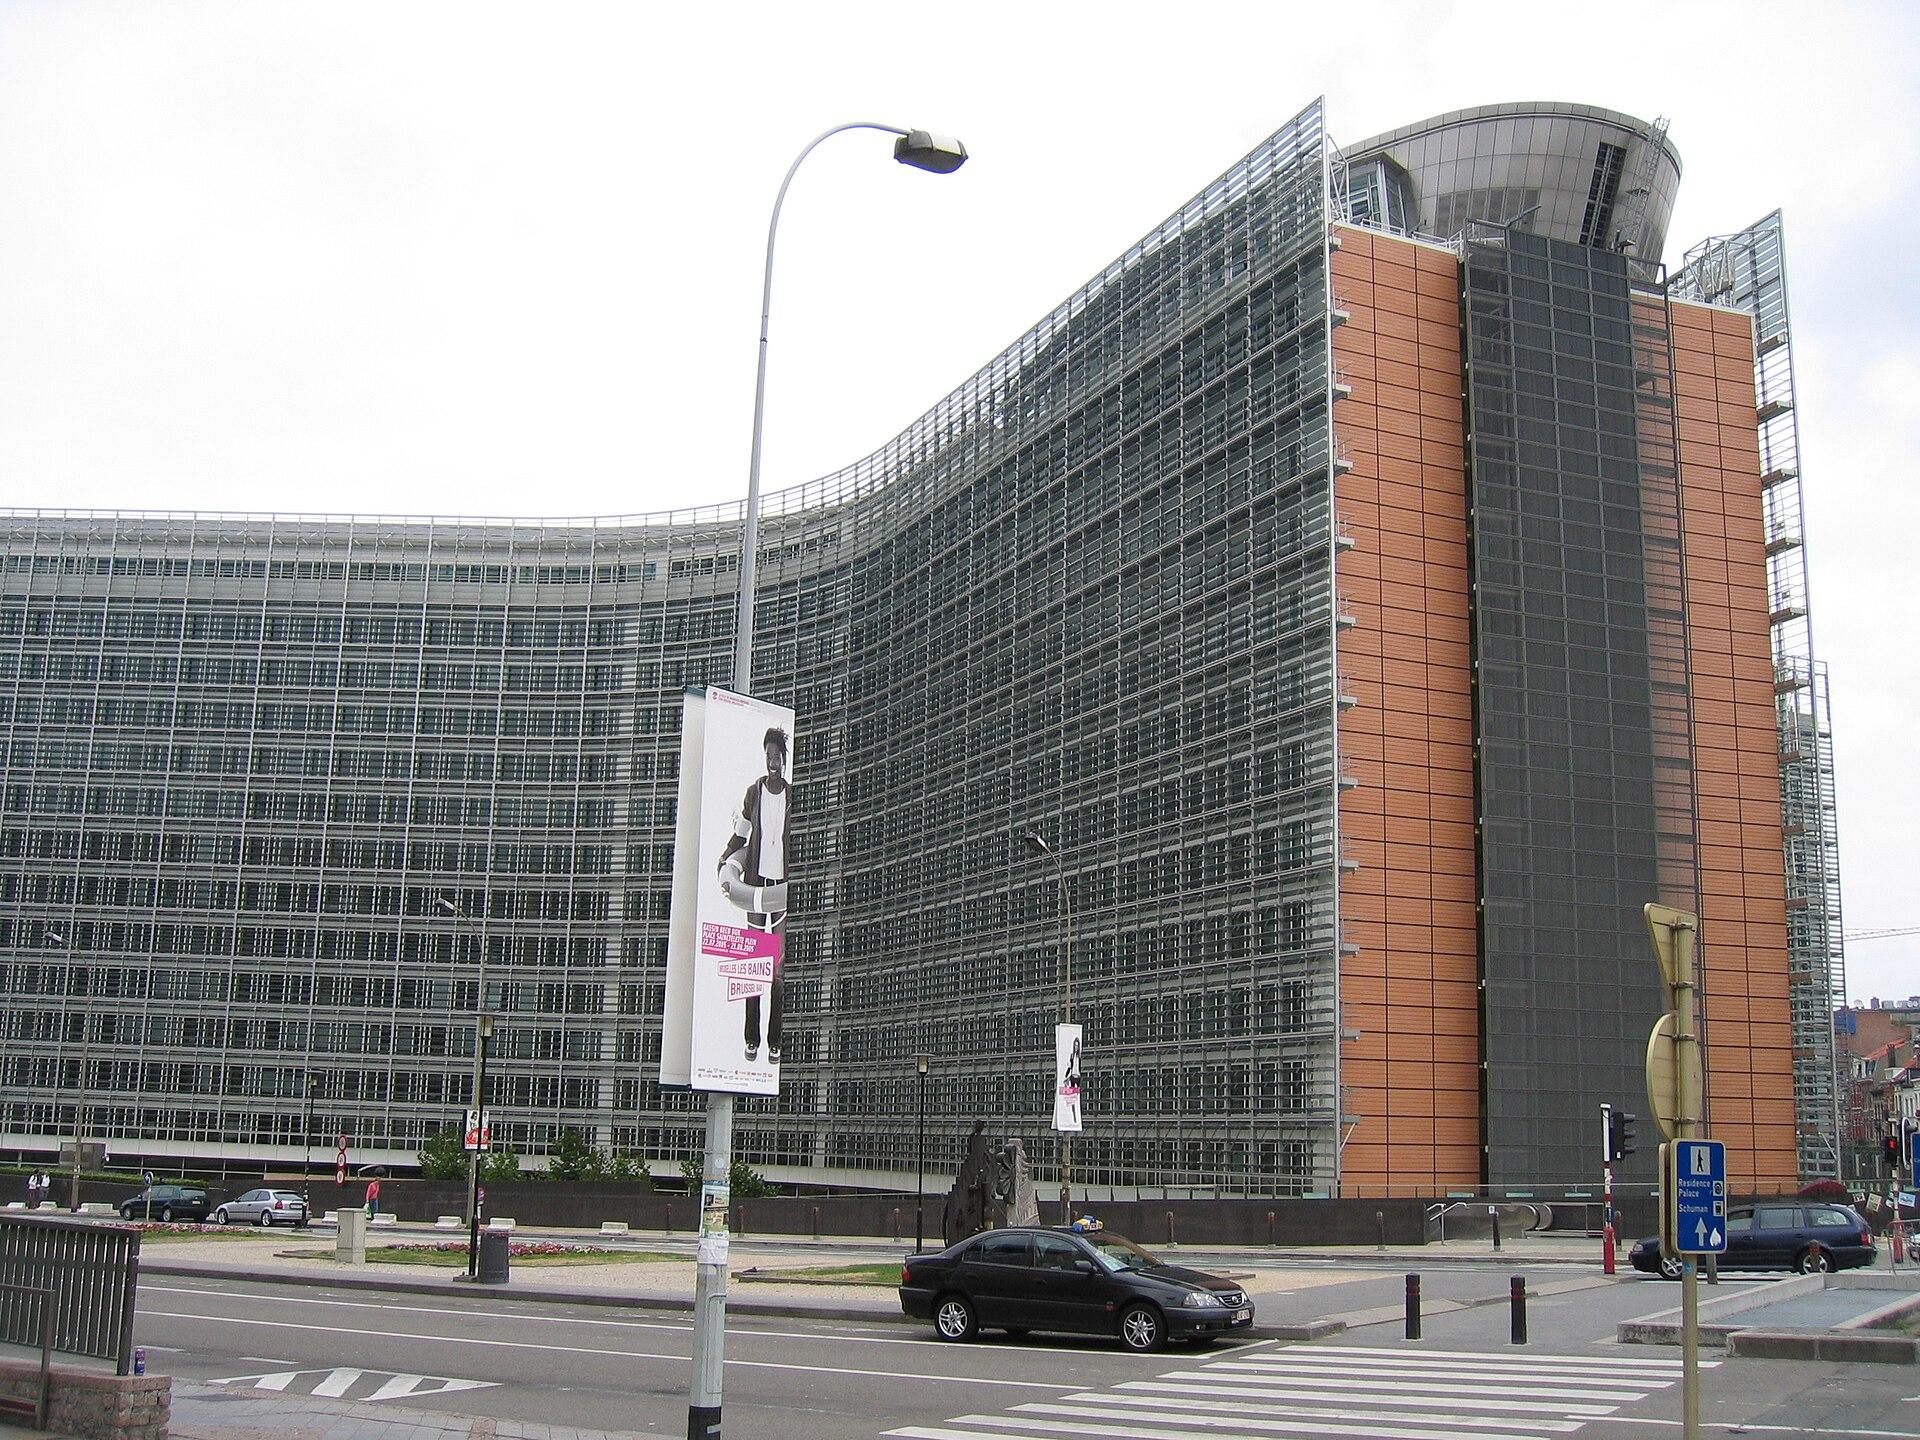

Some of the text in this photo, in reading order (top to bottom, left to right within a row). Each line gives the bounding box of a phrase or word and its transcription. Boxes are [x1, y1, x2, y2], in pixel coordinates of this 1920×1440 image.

[738, 963, 747, 974] LES
[748, 961, 771, 976] BAINS
[731, 983, 755, 995] BRUSSEL
[1678, 1178, 1711, 1188] Residence
[1678, 1188, 1700, 1198] Palace
[1678, 1203, 1709, 1213] Schuman
